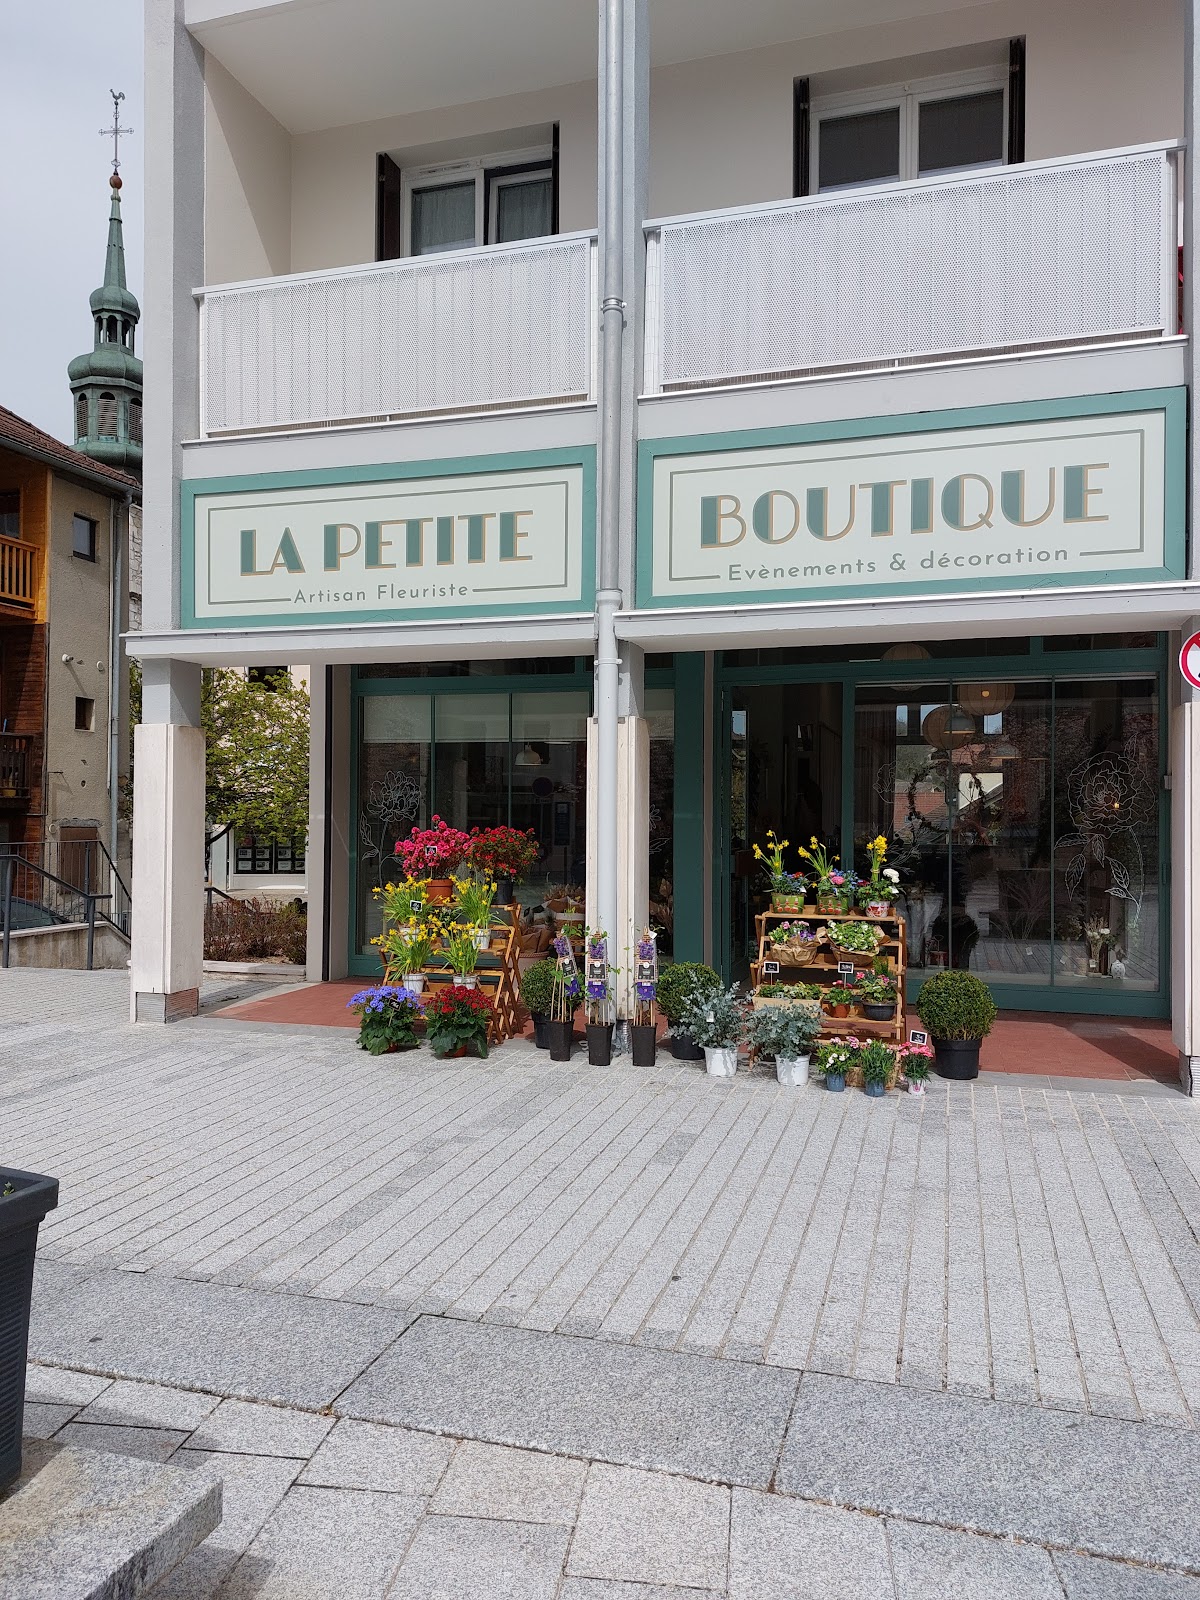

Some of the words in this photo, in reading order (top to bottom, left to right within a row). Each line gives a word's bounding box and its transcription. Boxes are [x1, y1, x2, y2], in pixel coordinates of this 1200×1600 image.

[700, 462, 1110, 549] BOUTIQUE
[240, 526, 306, 577] LA
[323, 510, 534, 572] PETITE
[728, 558, 877, 581] Evènements
[889, 553, 907, 571] &
[920, 547, 1069, 570] décoration
[294, 588, 366, 604] Artisan
[377, 583, 468, 600] Fleuriste
